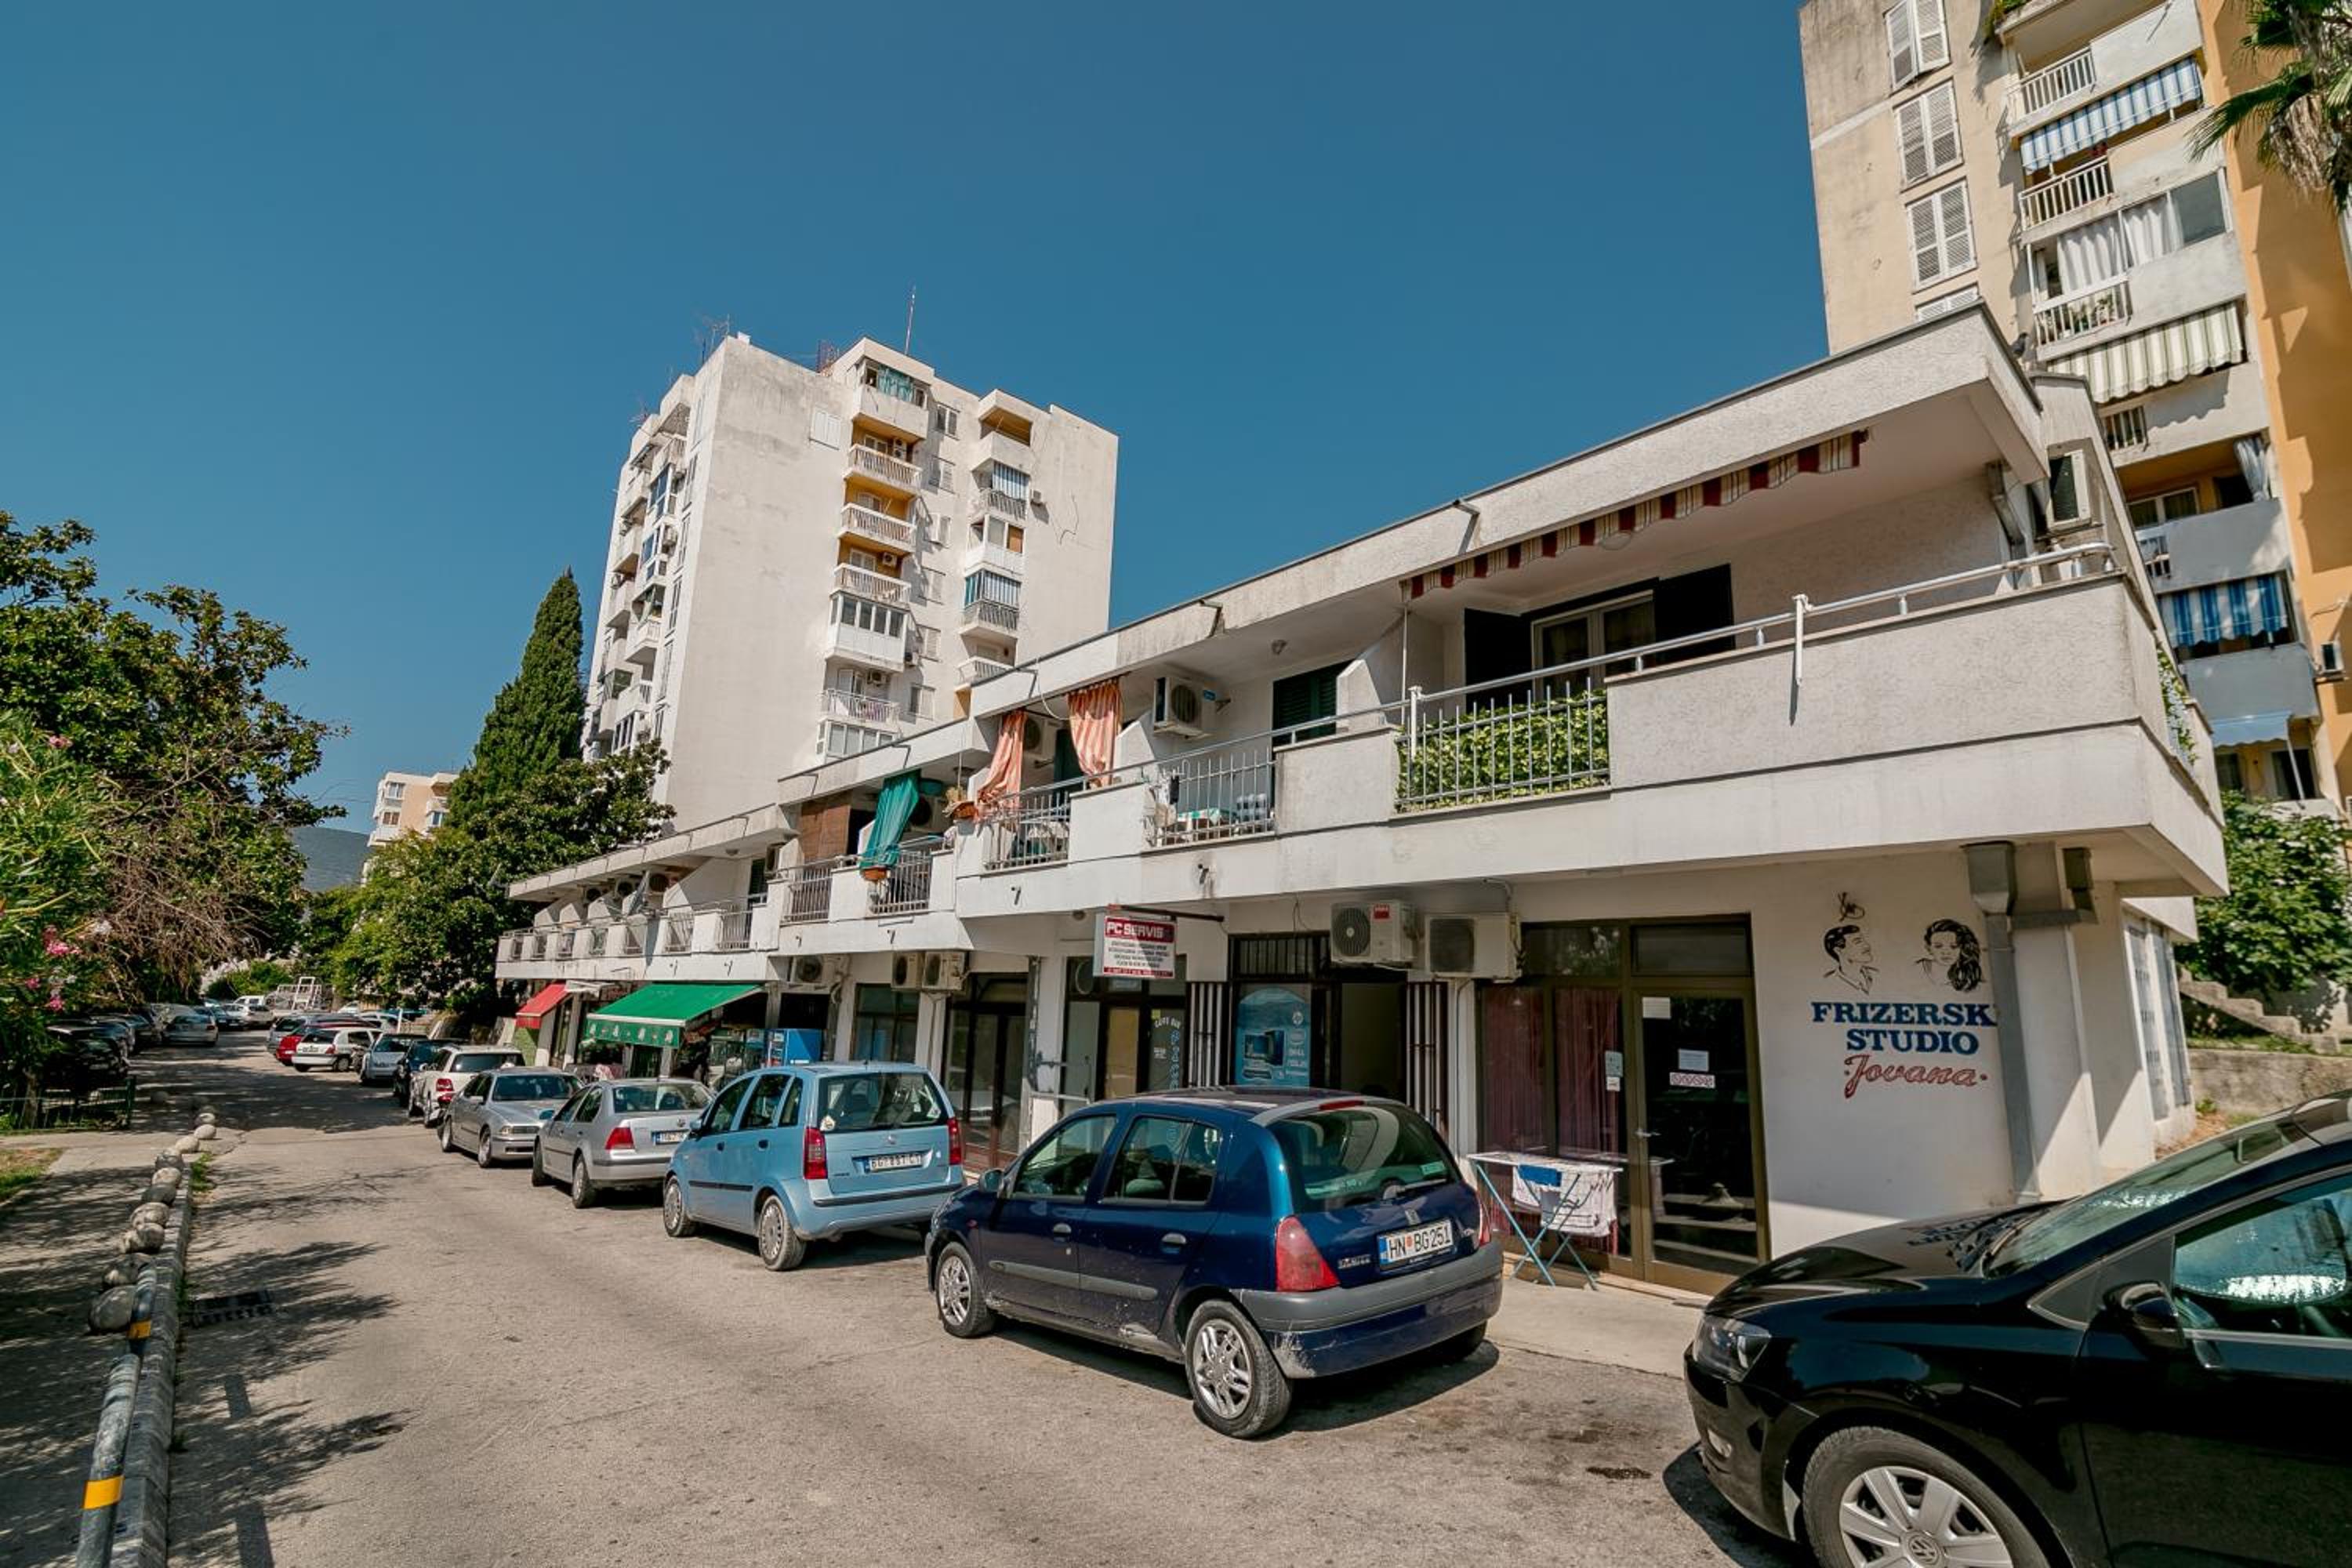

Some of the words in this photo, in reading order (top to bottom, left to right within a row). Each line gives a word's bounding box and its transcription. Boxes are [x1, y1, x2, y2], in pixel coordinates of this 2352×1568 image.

[1106, 921, 1122, 935] PC
[1123, 923, 1163, 939] SERVIS
[1811, 1001, 1998, 1026] FRIZERSK
[1846, 1029, 1980, 1055] STUDIO
[1388, 1236, 1406, 1260] HN
